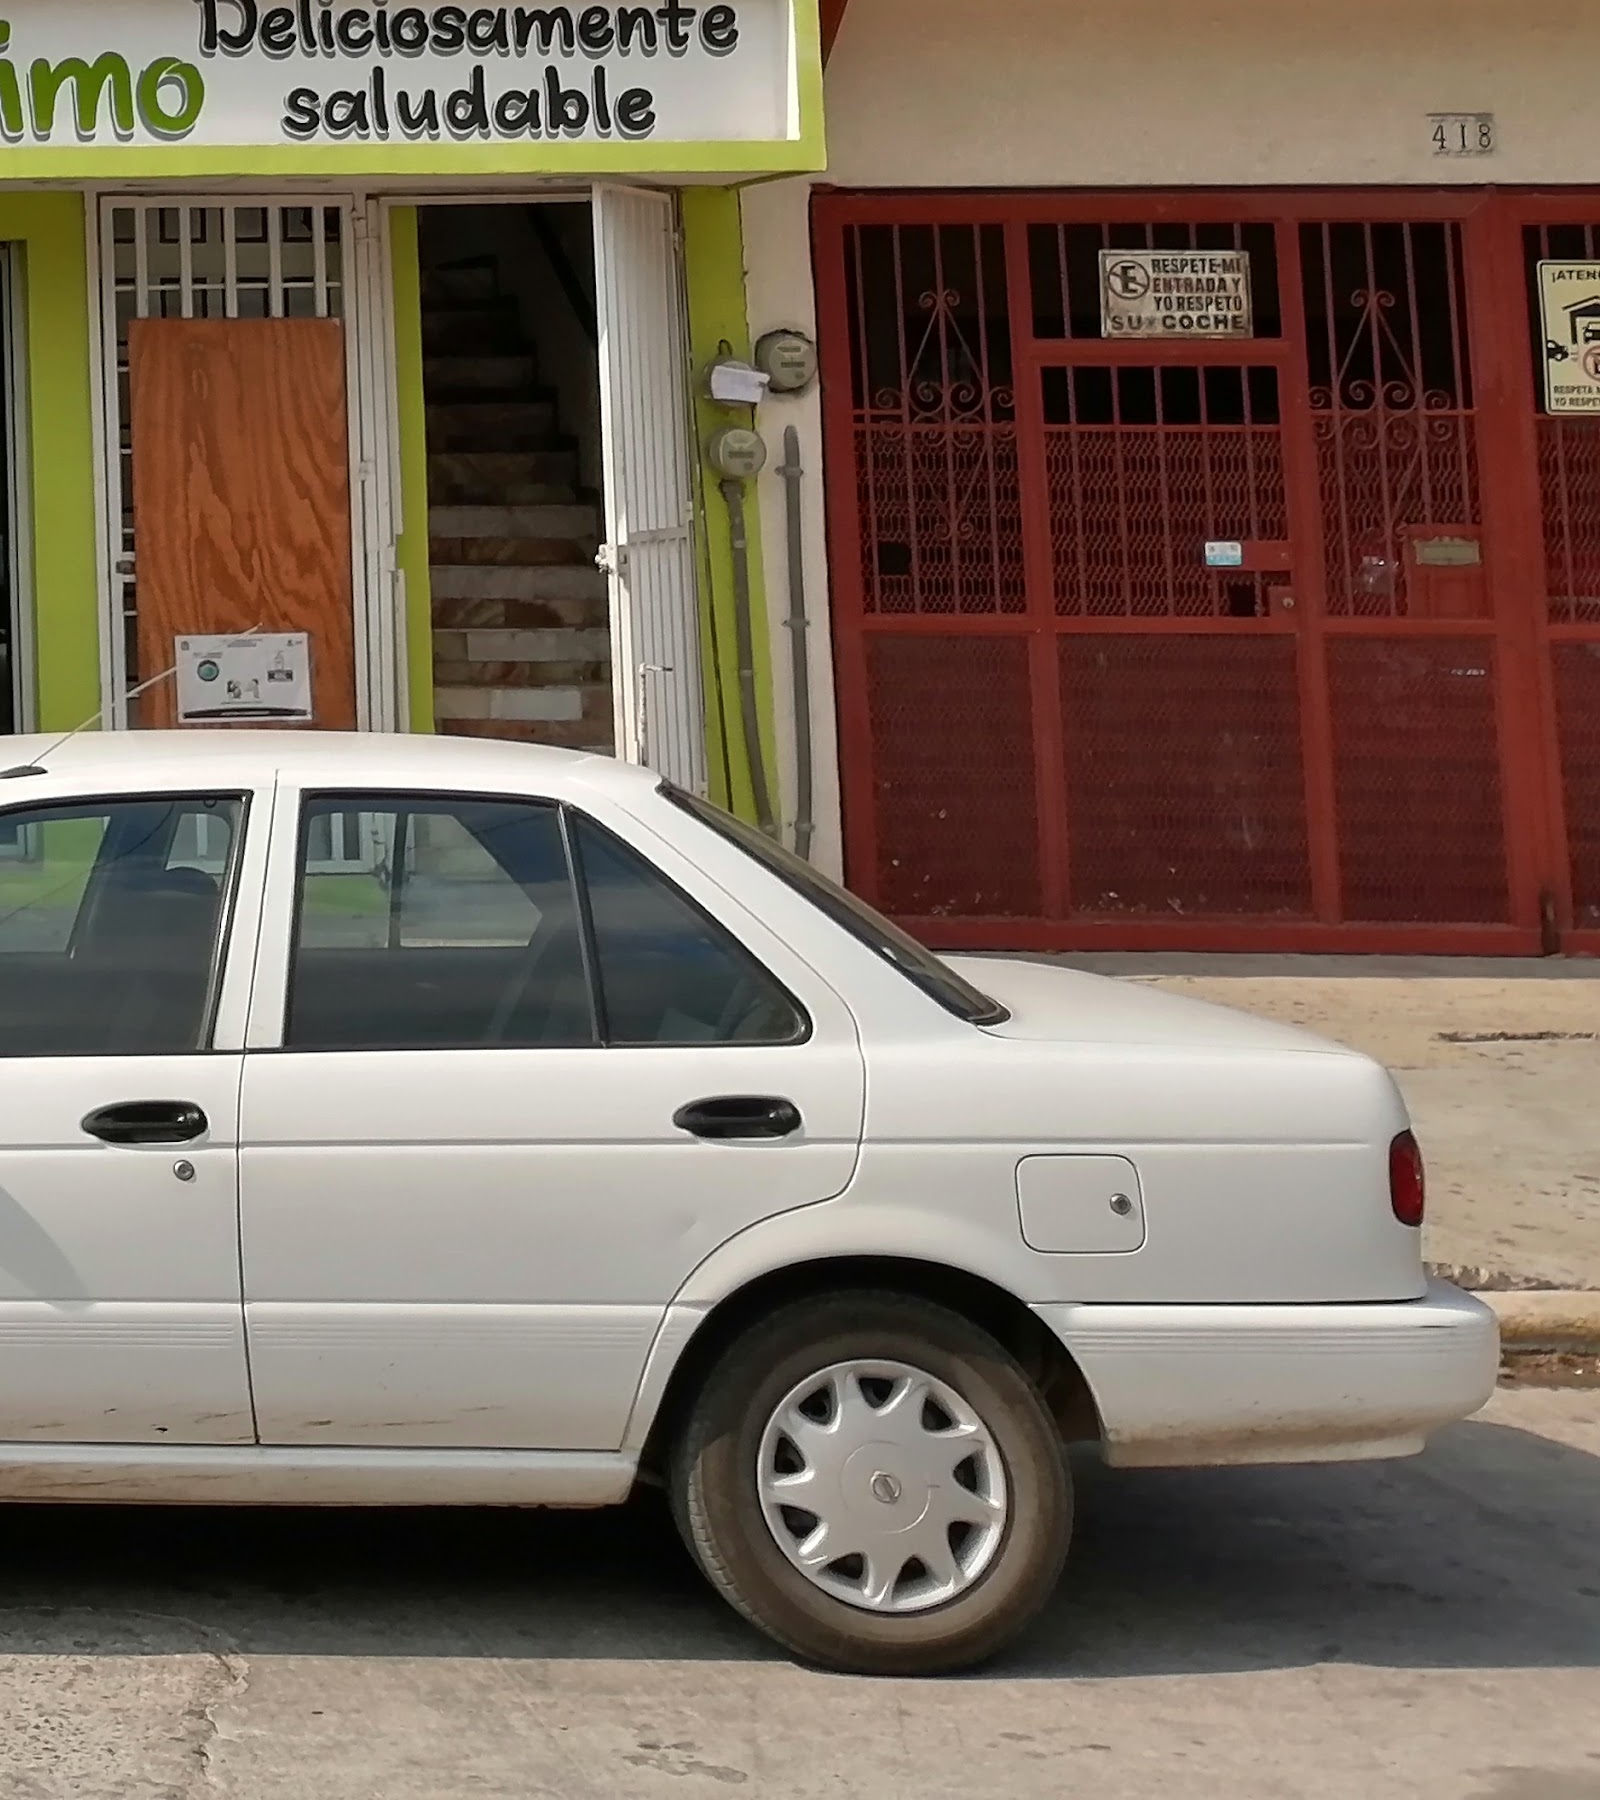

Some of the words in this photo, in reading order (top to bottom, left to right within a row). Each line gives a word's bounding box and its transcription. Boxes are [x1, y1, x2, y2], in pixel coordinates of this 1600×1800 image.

[280, 64, 657, 140] saludable
[1431, 123, 1492, 150] 418
[1152, 277, 1227, 294] ENTRADA
[1231, 278, 1241, 293] Y
[1154, 296, 1173, 312] YO
[1176, 296, 1242, 313] RESPETO
[1111, 315, 1143, 331] SU
[1161, 314, 1245, 331] COCHE
